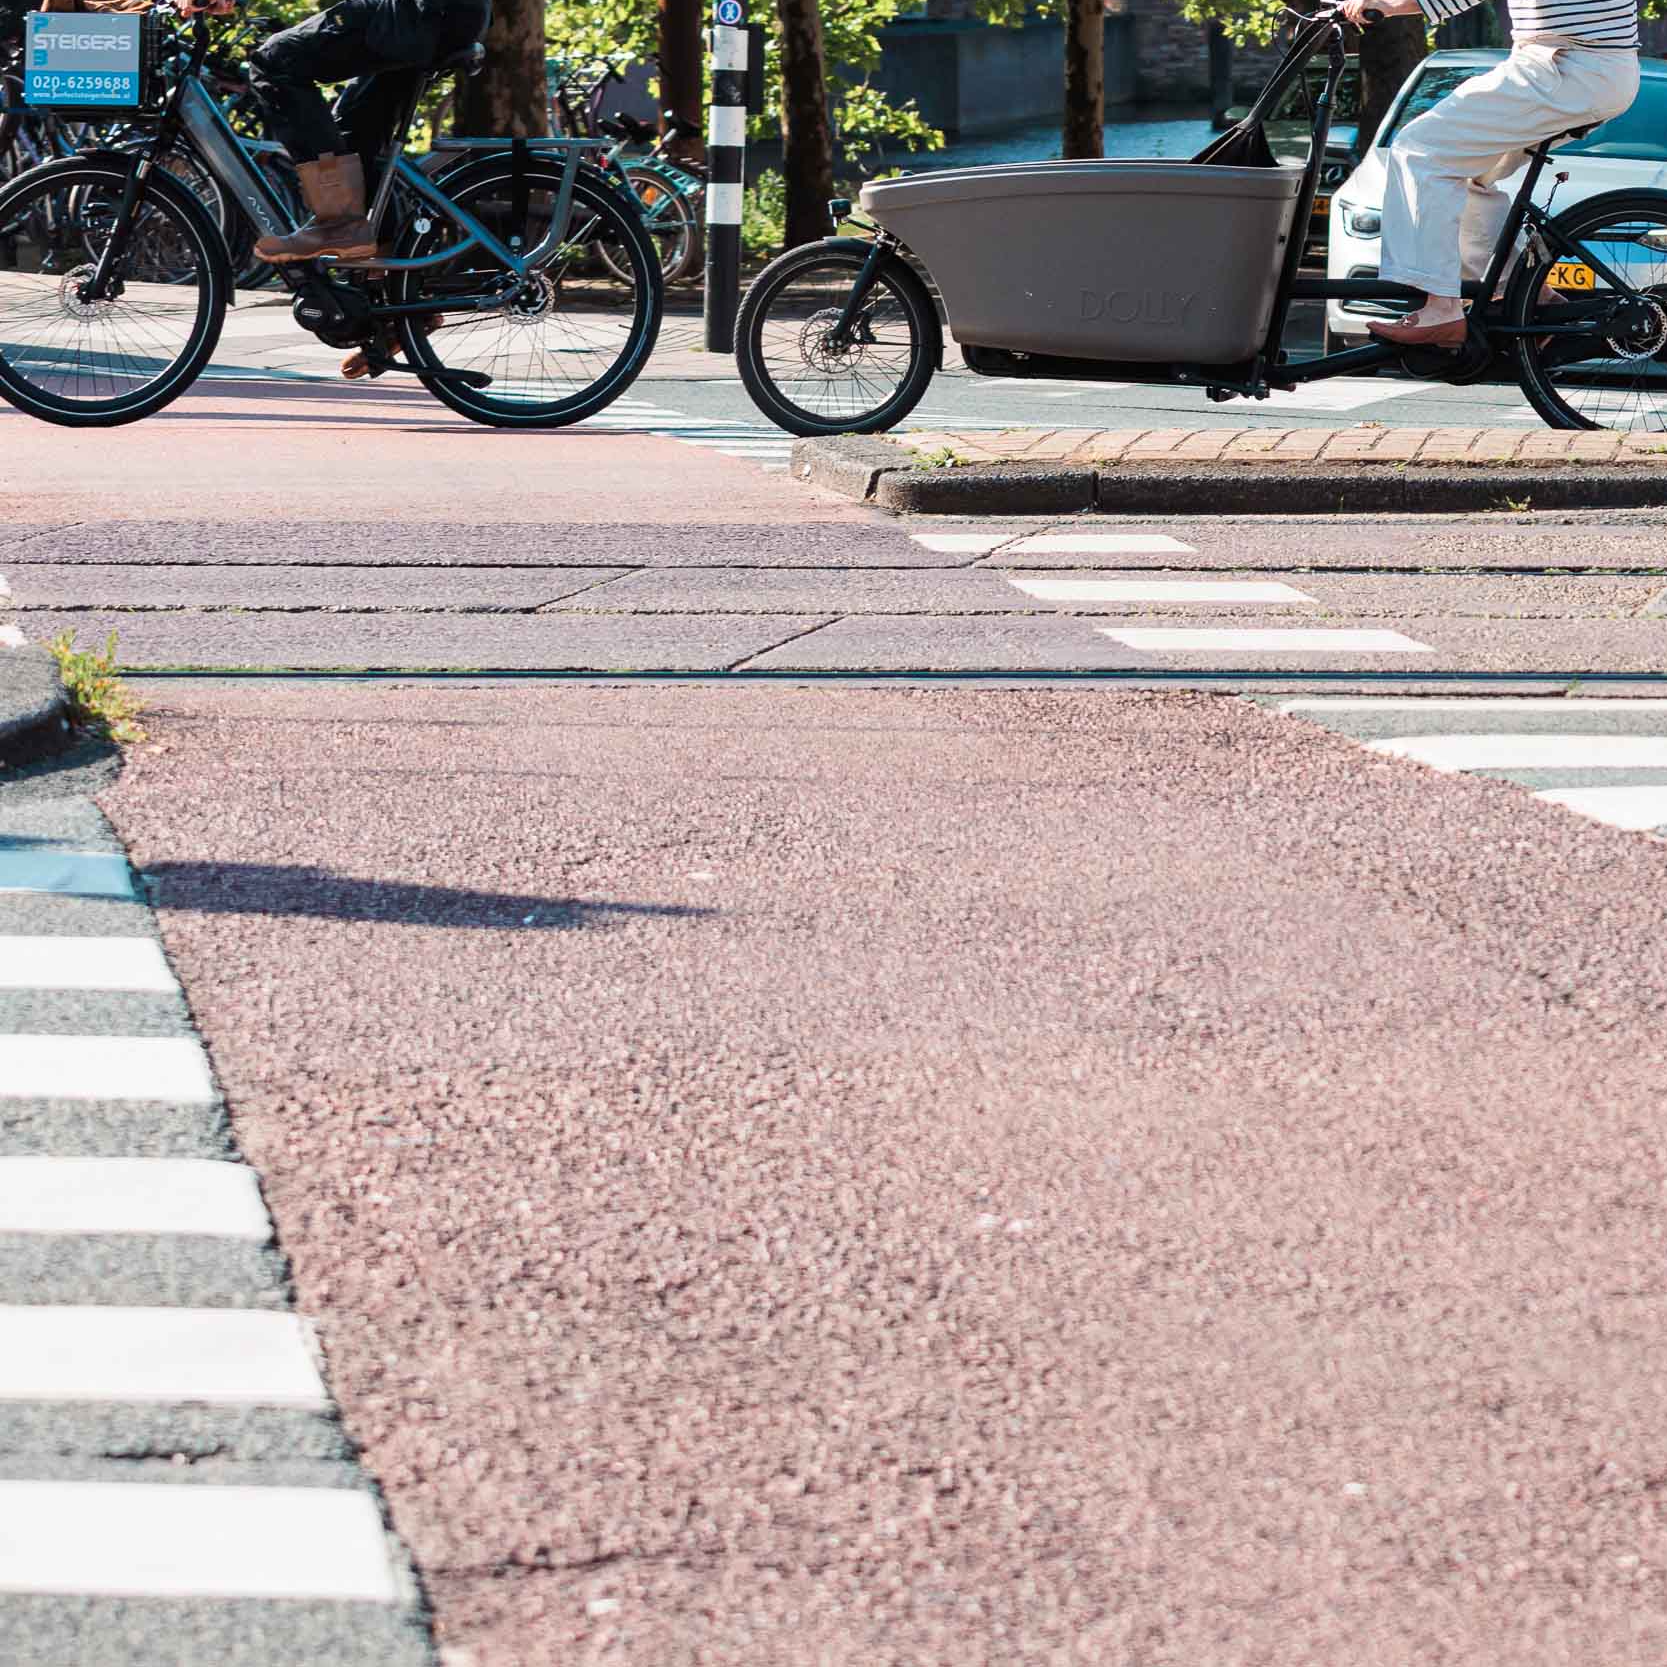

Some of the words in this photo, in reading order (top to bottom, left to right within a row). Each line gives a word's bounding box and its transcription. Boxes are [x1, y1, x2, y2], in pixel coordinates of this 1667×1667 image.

[33, 33, 132, 51] STEIGERS
[33, 75, 131, 90] 020-6259688
[1550, 267, 1586, 285] -KG
[1080, 286, 1199, 325] DOLLY
